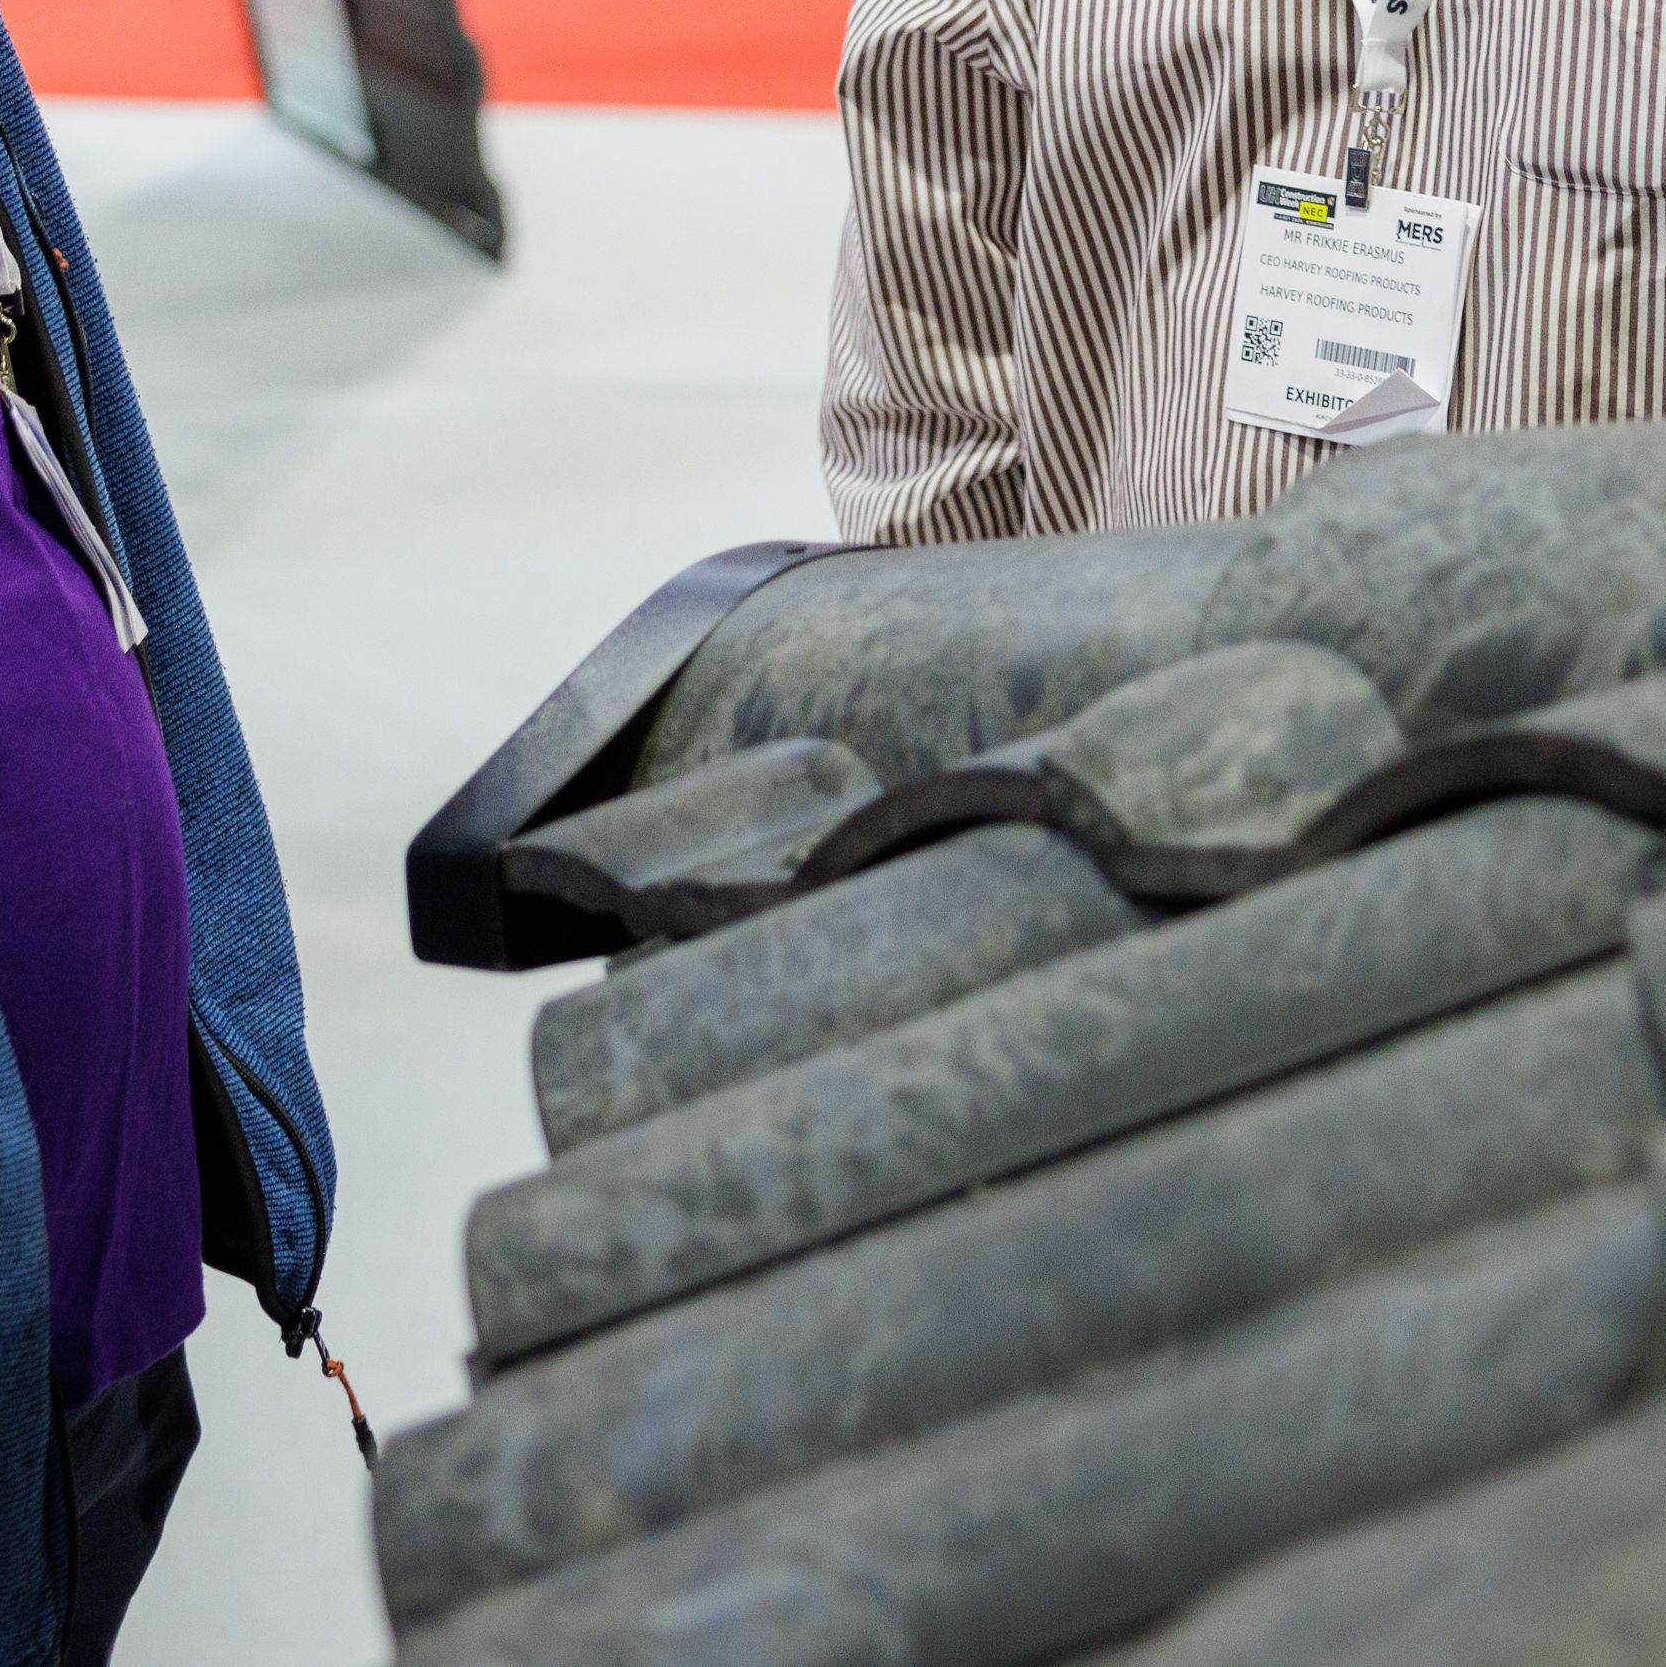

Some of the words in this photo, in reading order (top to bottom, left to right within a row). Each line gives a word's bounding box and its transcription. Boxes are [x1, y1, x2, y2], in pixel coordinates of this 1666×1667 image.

[1281, 188, 1326, 205] Construction
[1303, 206, 1324, 218] NEC
[1396, 219, 1444, 244] MERS
[1284, 229, 1302, 244] MR
[1306, 232, 1350, 253] FRIKKIE
[1352, 242, 1405, 265] ERASMUS
[1260, 253, 1281, 267] CEO
[1284, 258, 1323, 275] HARVEY
[1325, 266, 1369, 285] ROOFING
[1370, 275, 1421, 296] PRODUCTS
[1260, 284, 1304, 302] HARVEY
[1306, 292, 1355, 314] ROOFING
[1357, 303, 1414, 326] PRODUCTS
[1286, 386, 1354, 412] EXHIBITO
